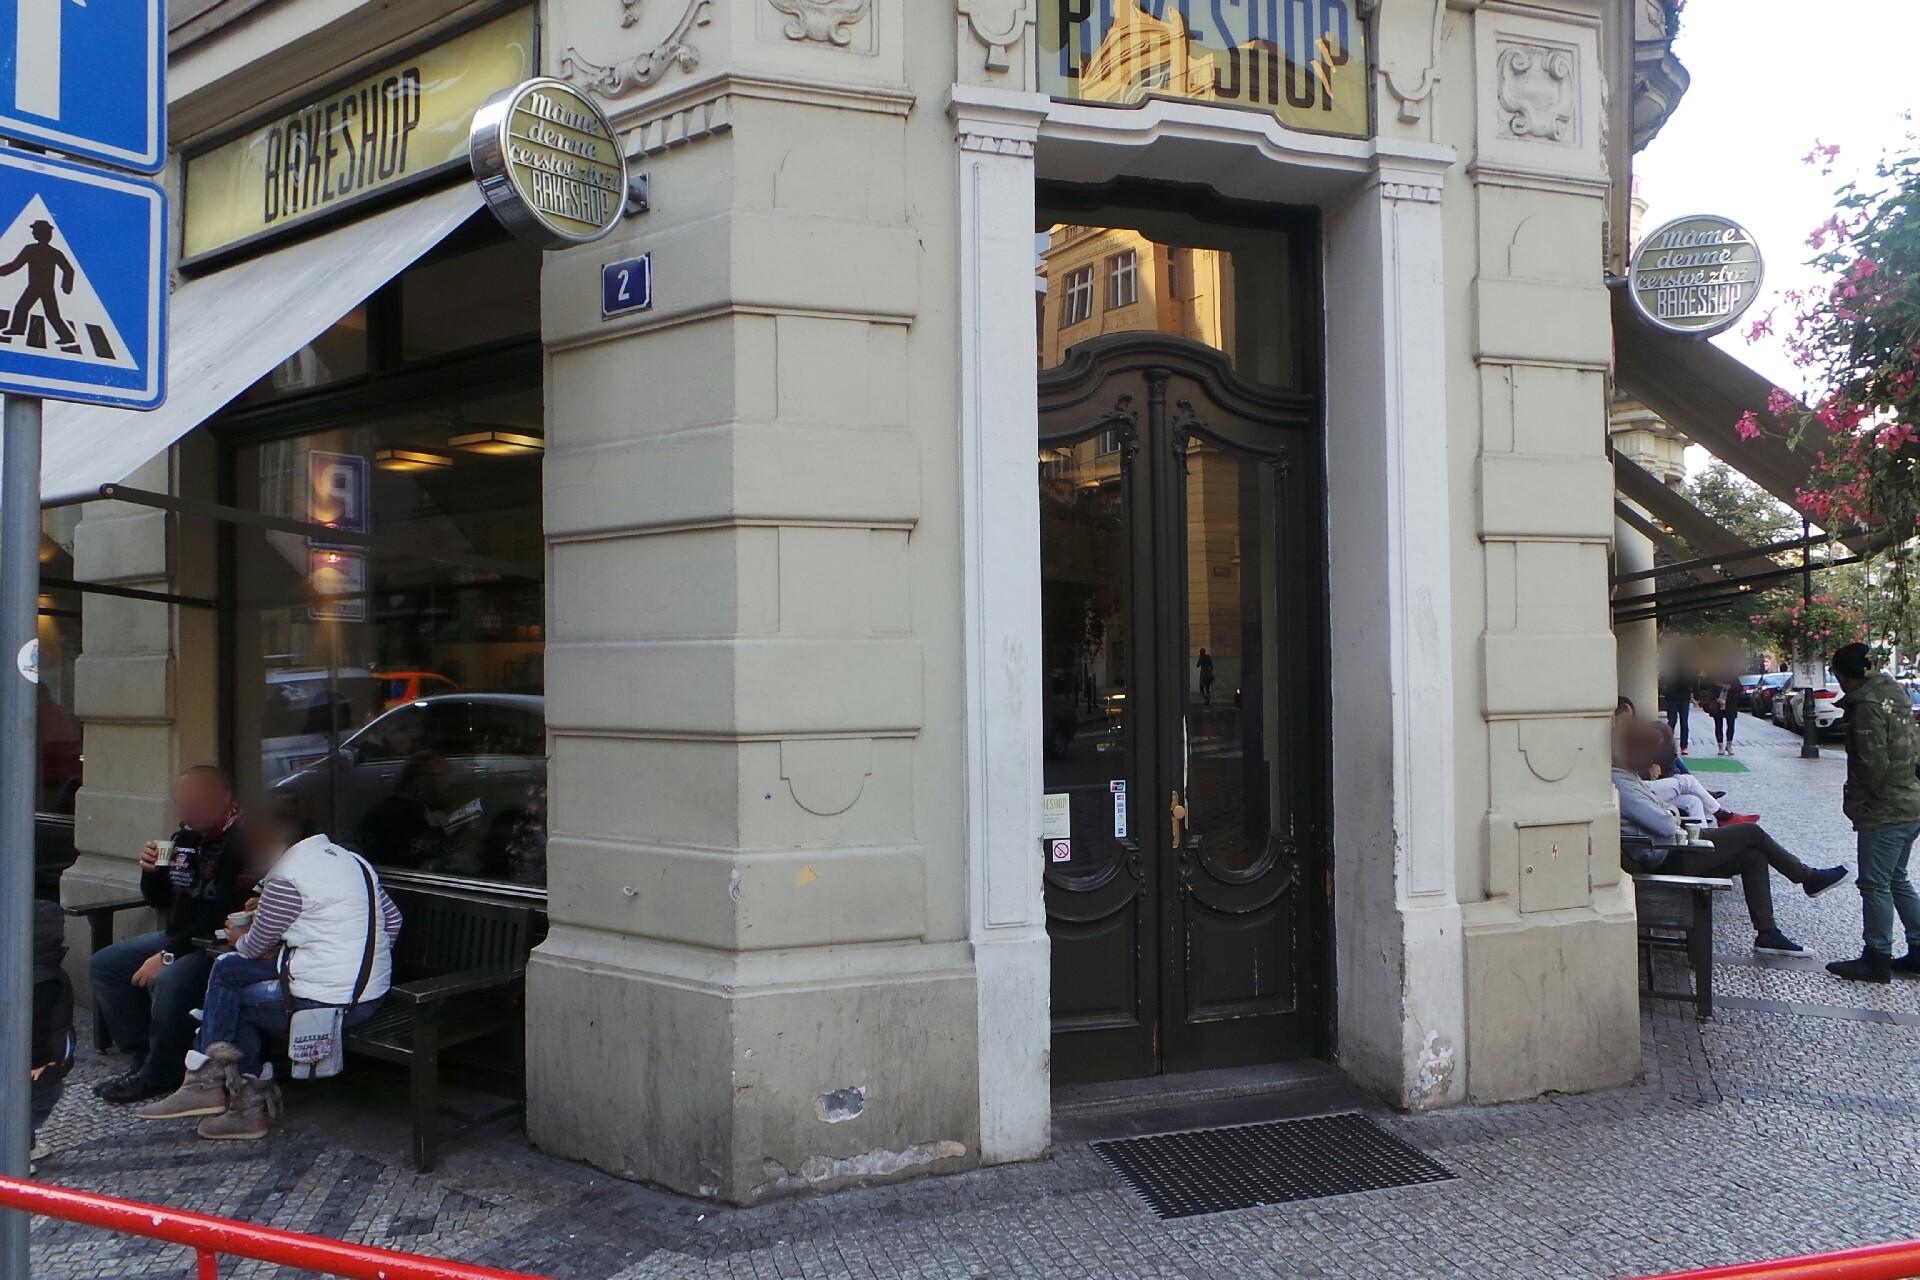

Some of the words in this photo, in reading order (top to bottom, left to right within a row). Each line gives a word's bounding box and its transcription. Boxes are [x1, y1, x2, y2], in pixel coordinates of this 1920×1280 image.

[1059, 0, 1349, 111] BAKESHOP
[264, 66, 422, 223] BAKESHOP
[532, 169, 609, 226] BAKESHOP
[616, 268, 630, 302] 2
[1657, 284, 1741, 316] BAKESHOP
